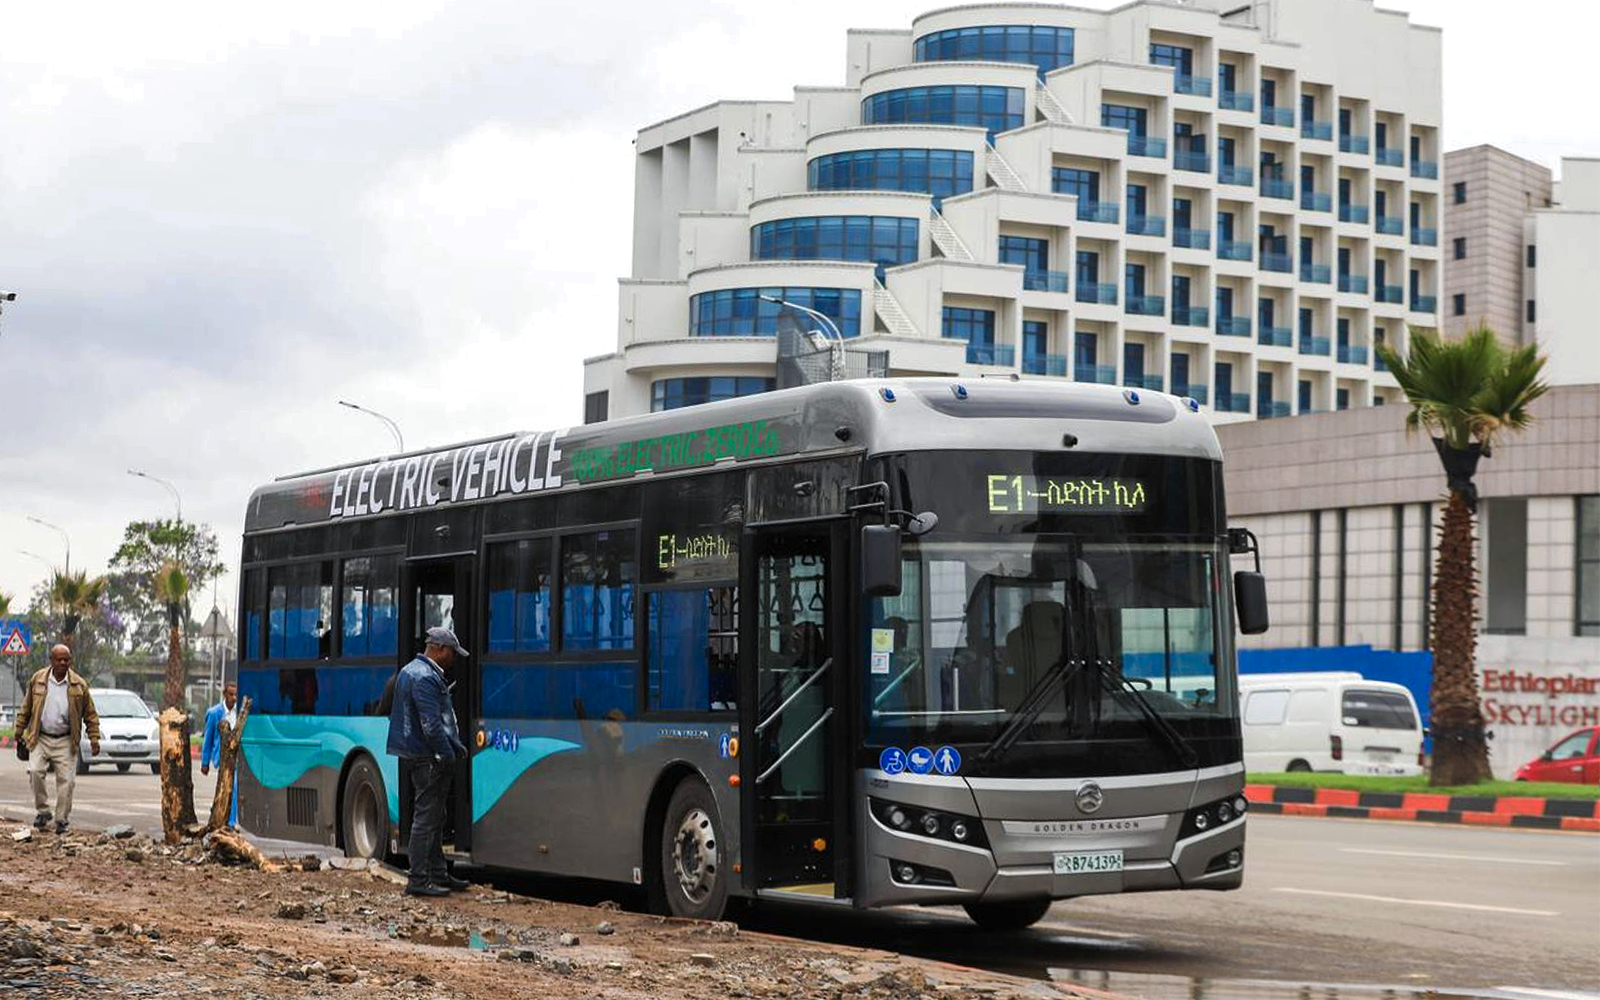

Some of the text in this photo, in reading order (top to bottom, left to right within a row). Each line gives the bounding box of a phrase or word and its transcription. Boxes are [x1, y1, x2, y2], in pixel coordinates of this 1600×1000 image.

[329, 454, 449, 517] ELECTRIC
[449, 427, 571, 502] VEHICLE
[1034, 820, 1140, 832] GOLDEN DRAGON
